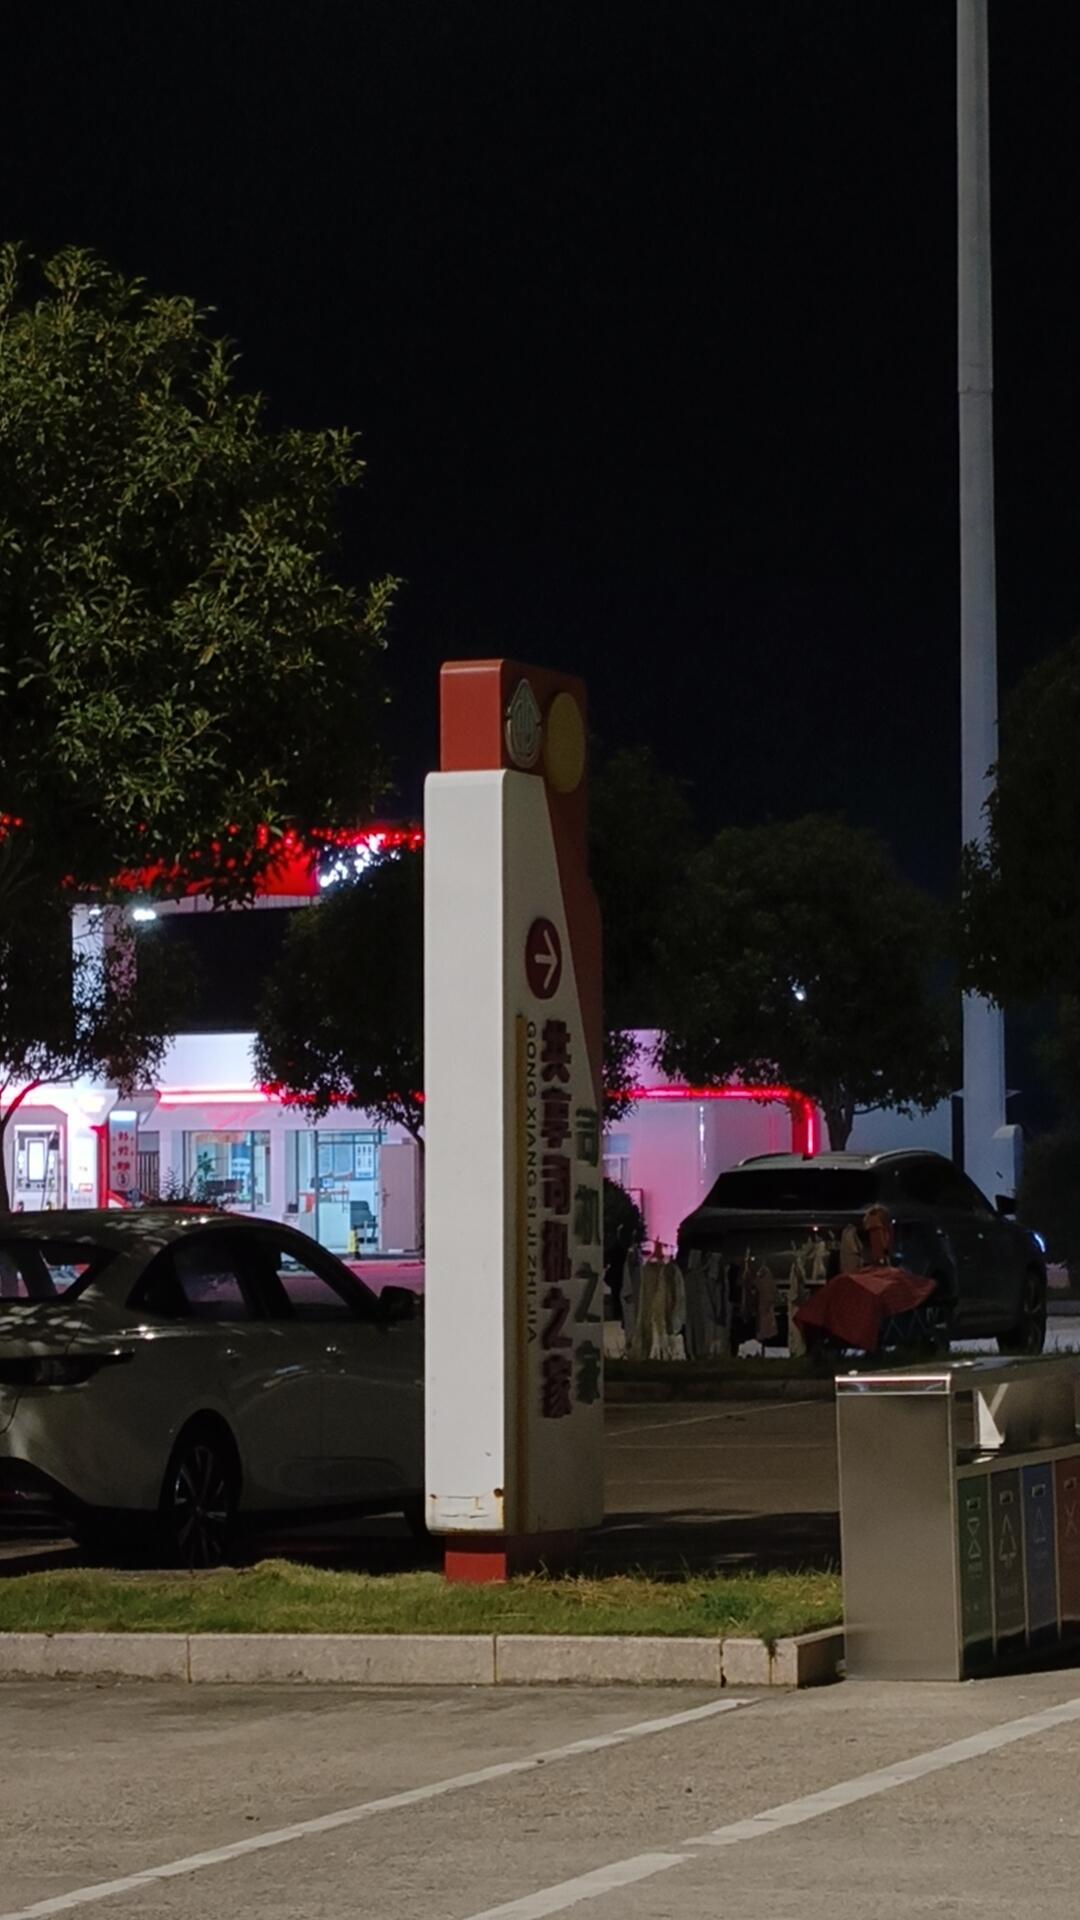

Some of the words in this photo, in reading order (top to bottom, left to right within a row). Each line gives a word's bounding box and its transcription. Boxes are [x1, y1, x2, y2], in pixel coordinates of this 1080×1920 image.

[527, 1022, 537, 1098] GONG
[527, 1107, 537, 1187] XIANG
[527, 1196, 537, 1218] SI
[541, 1019, 572, 1418] 共享司机之家
[527, 1227, 537, 1246] JI
[527, 1255, 537, 1295] ZHI
[527, 1306, 537, 1343] JIA
